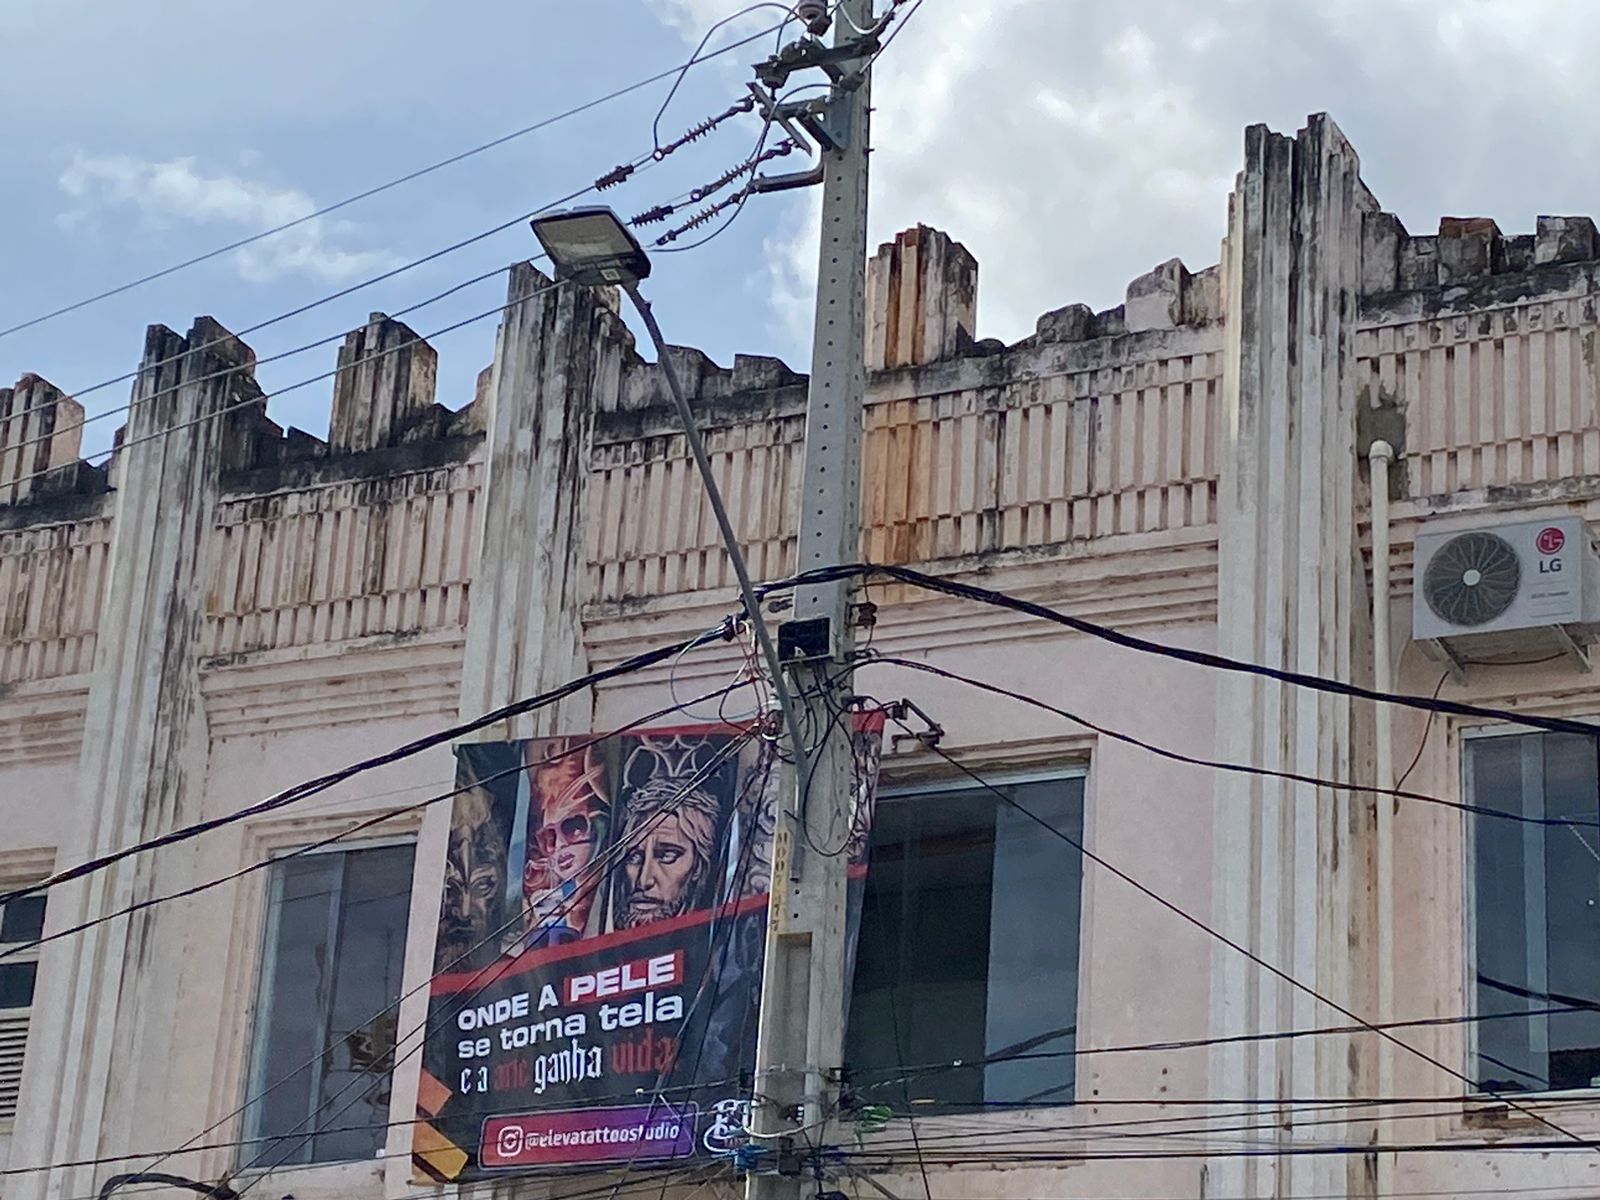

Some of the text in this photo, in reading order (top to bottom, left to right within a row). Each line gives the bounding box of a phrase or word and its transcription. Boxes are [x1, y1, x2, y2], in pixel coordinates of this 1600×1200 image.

[1539, 558, 1562, 574] LG
[458, 953, 676, 1031] ONDE A PELE
[458, 991, 684, 1059] se torna tela
[477, 1066, 488, 1092] a
[533, 1038, 603, 1094] ganha
